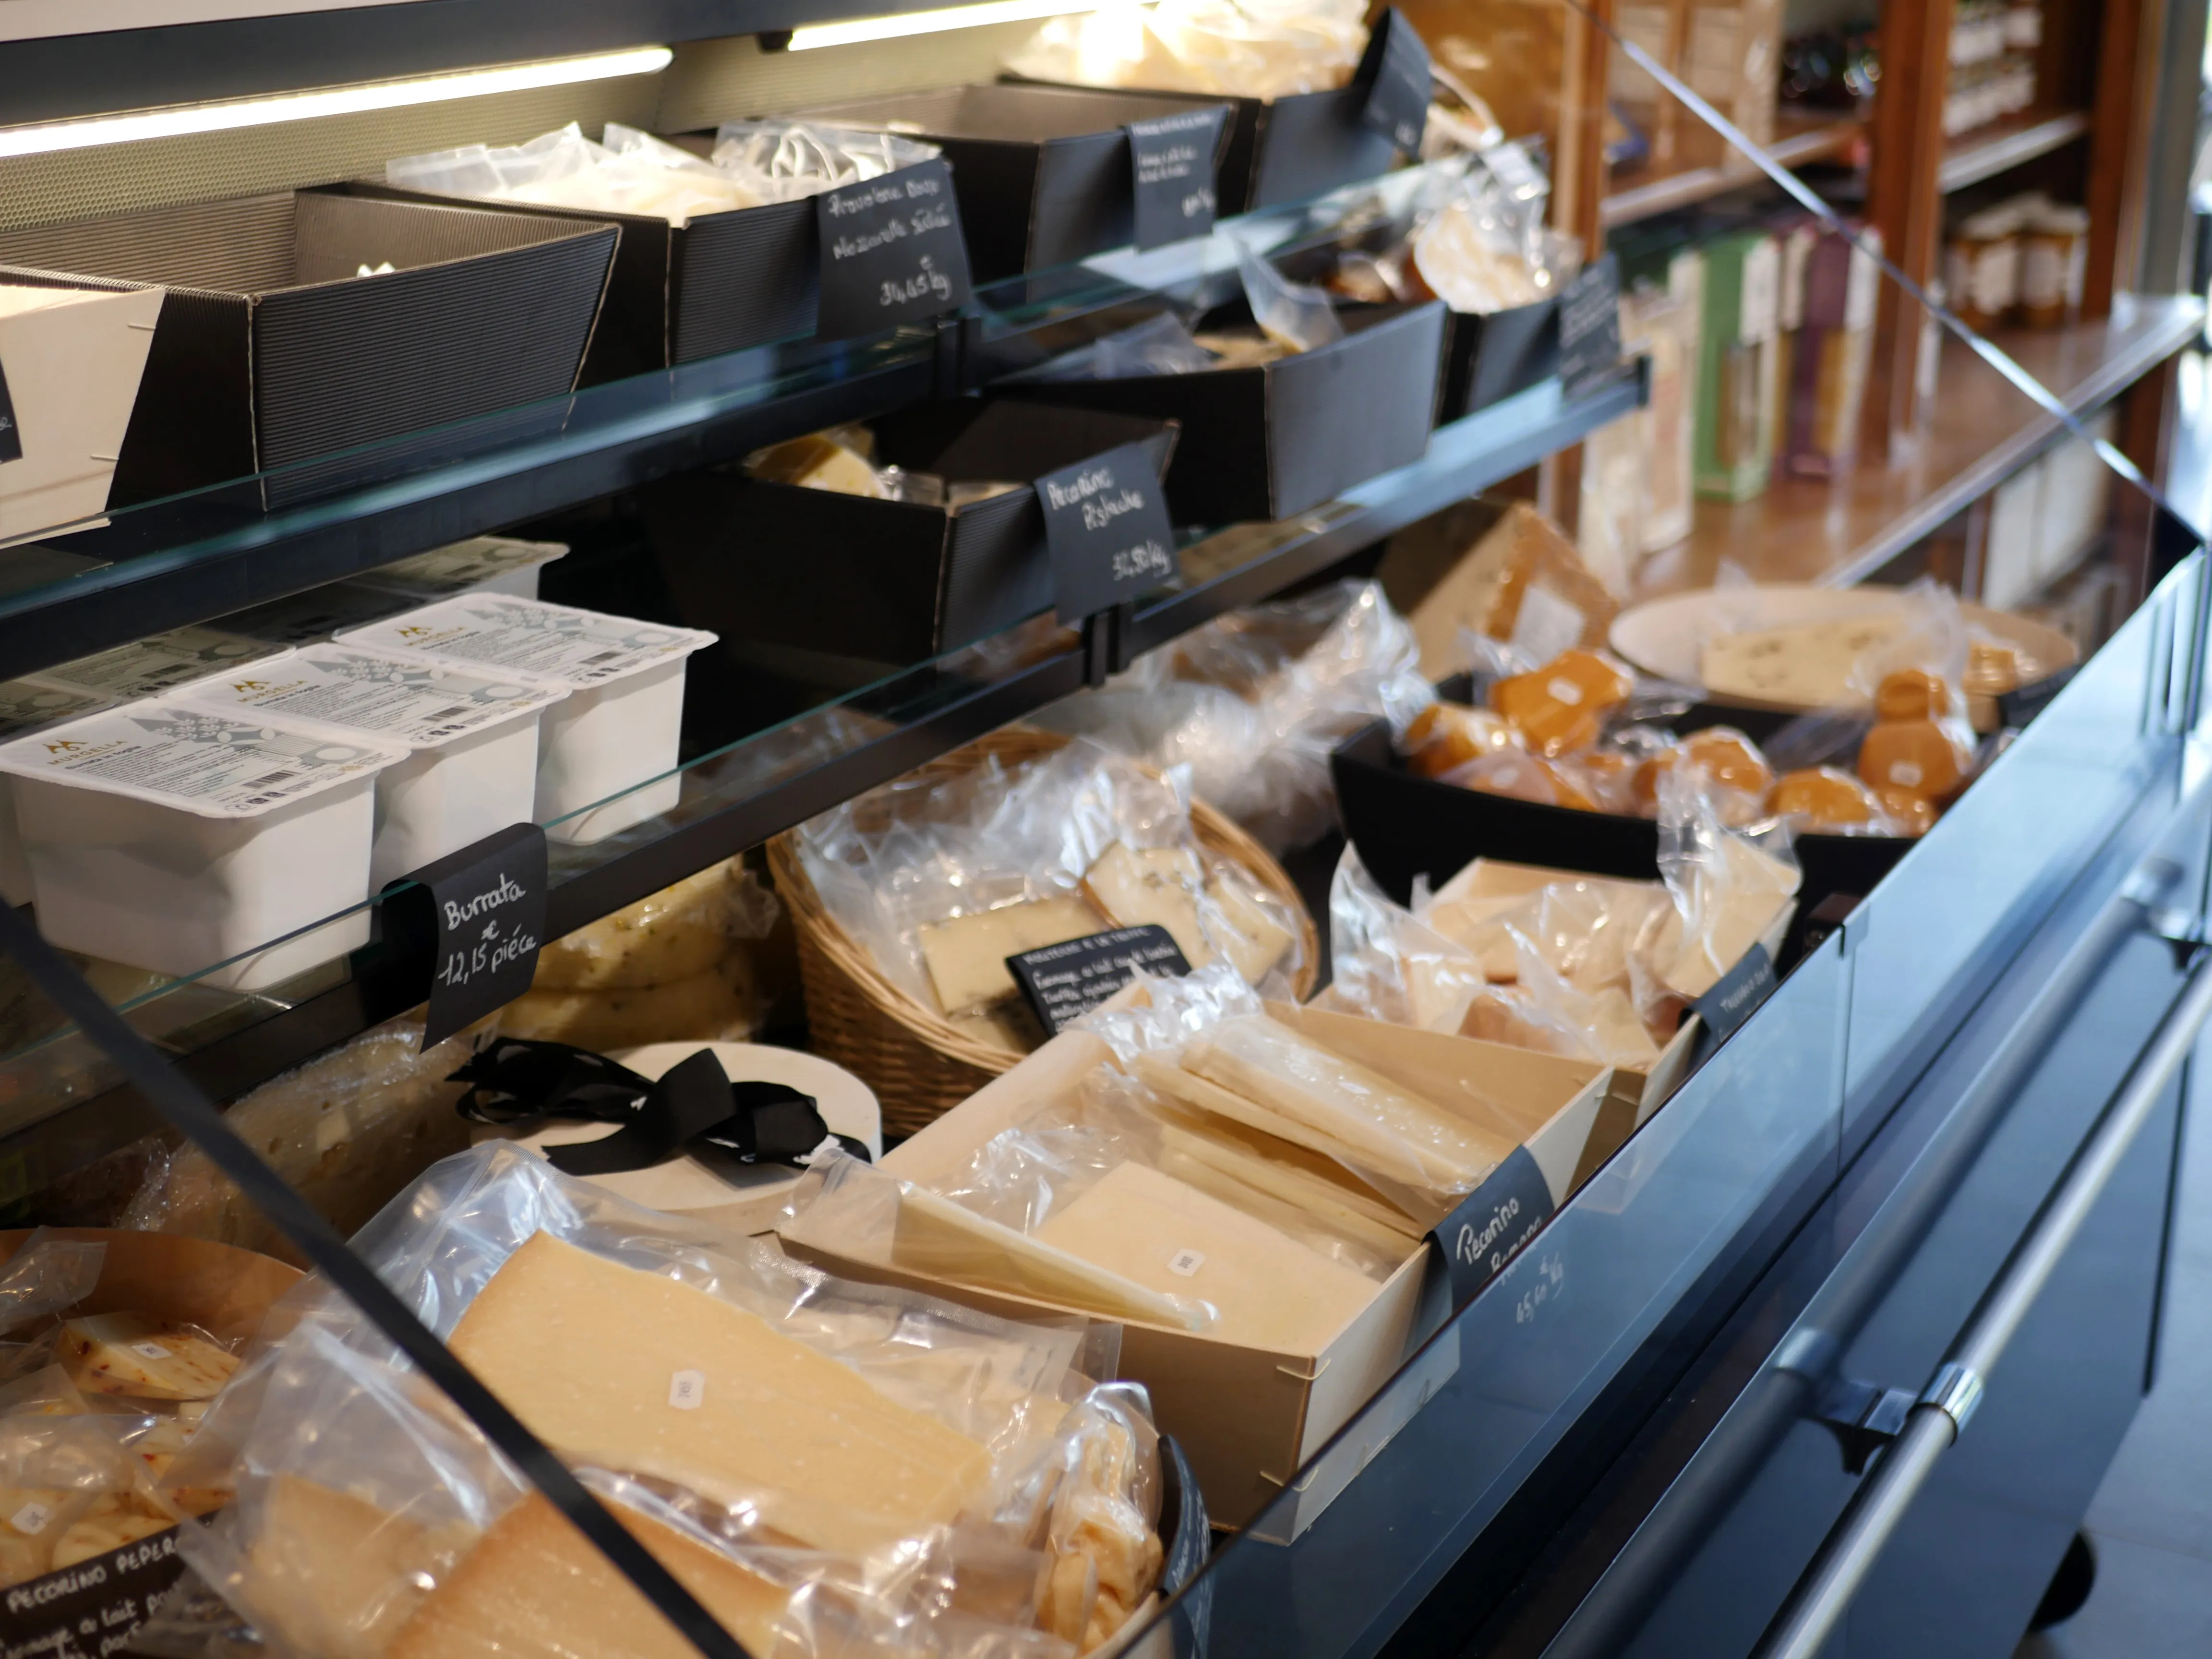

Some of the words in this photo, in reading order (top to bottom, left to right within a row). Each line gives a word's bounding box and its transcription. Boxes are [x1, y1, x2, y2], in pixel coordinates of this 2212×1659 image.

[47, 740, 128, 765] MURGELLA
[444, 872, 527, 931] Burrata
[437, 942, 487, 986] 12,15
[1456, 1196, 1520, 1265] Pecorino
